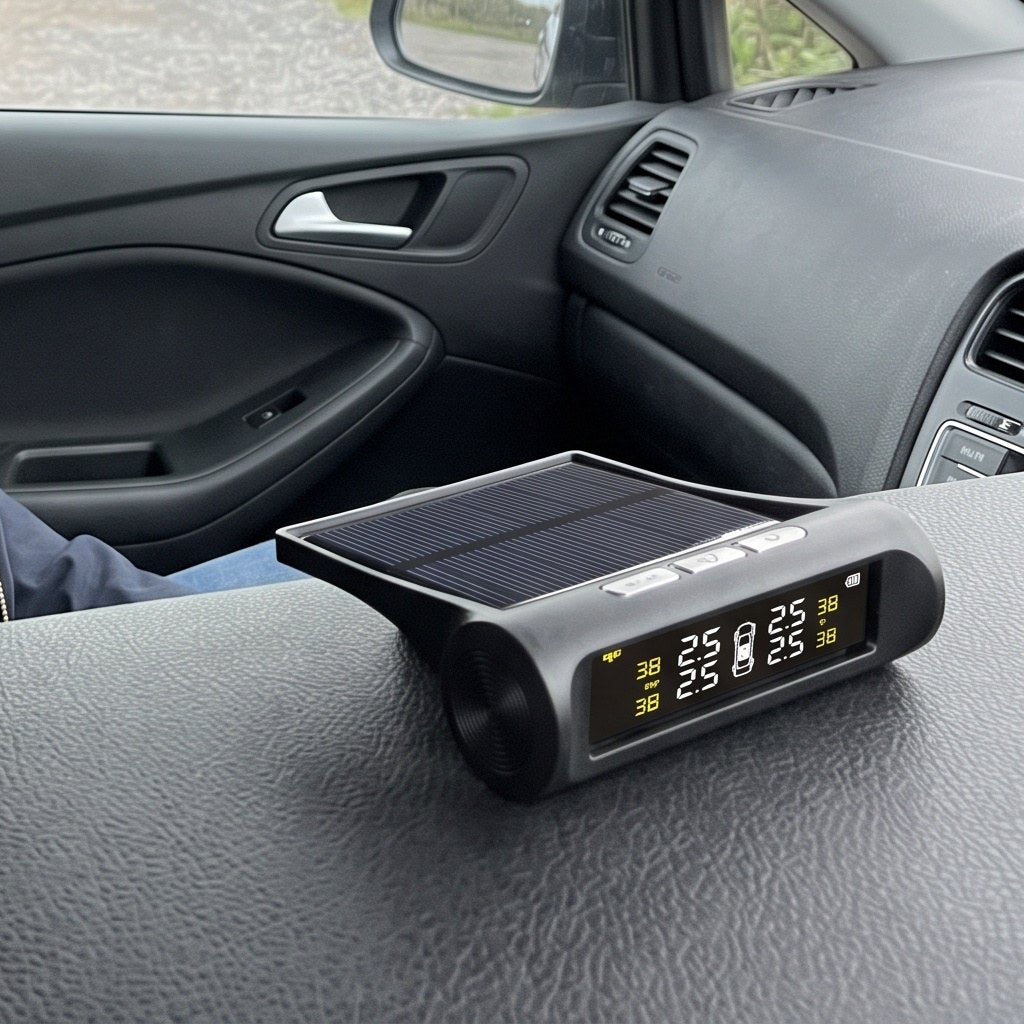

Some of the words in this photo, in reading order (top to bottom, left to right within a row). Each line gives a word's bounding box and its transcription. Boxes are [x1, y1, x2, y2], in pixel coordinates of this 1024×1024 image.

[768, 598, 805, 635] 2.5
[817, 594, 838, 616] 38
[678, 626, 721, 667] 2.5
[767, 629, 804, 666] 2.5
[816, 627, 837, 648] 38
[636, 656, 661, 680] 38
[677, 660, 719, 700] 2.5
[635, 693, 659, 717] 38
